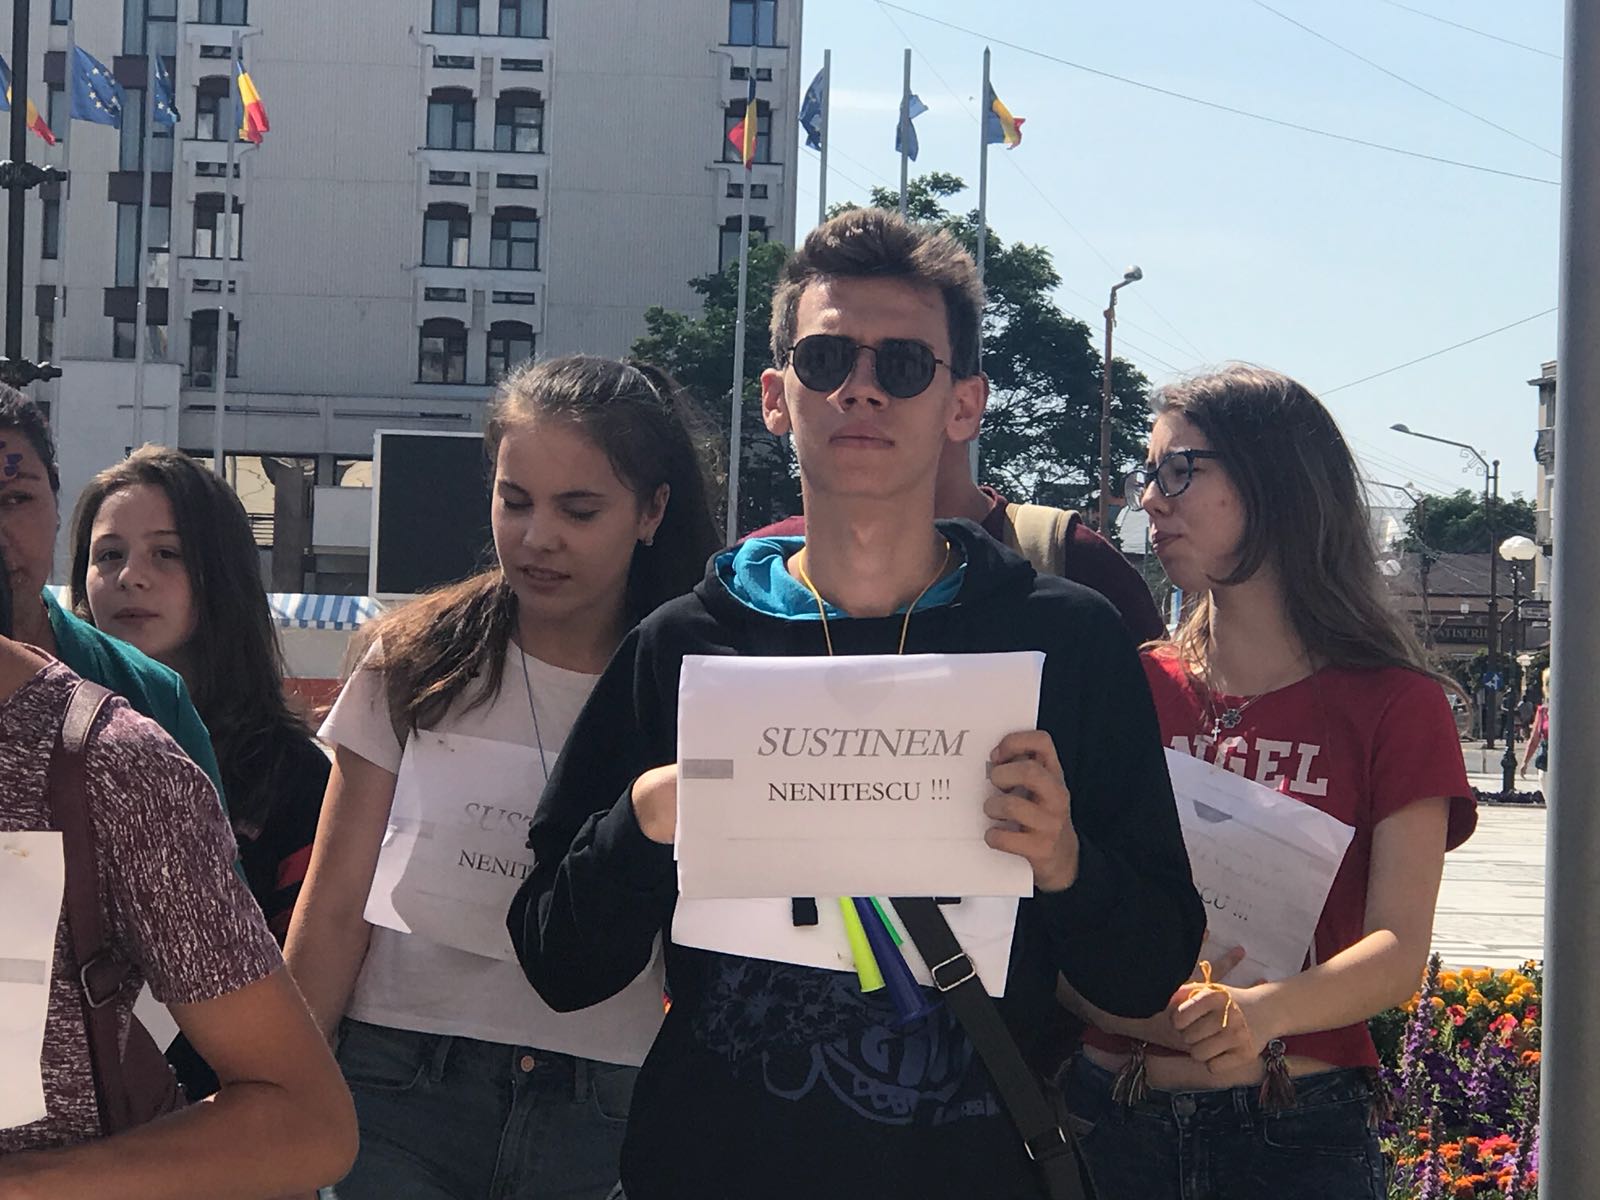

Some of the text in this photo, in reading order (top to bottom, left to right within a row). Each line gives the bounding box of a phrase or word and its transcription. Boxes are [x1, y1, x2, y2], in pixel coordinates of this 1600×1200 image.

[757, 726, 970, 758] SUSTINEM
[768, 778, 950, 801] NENITESCU !!!
